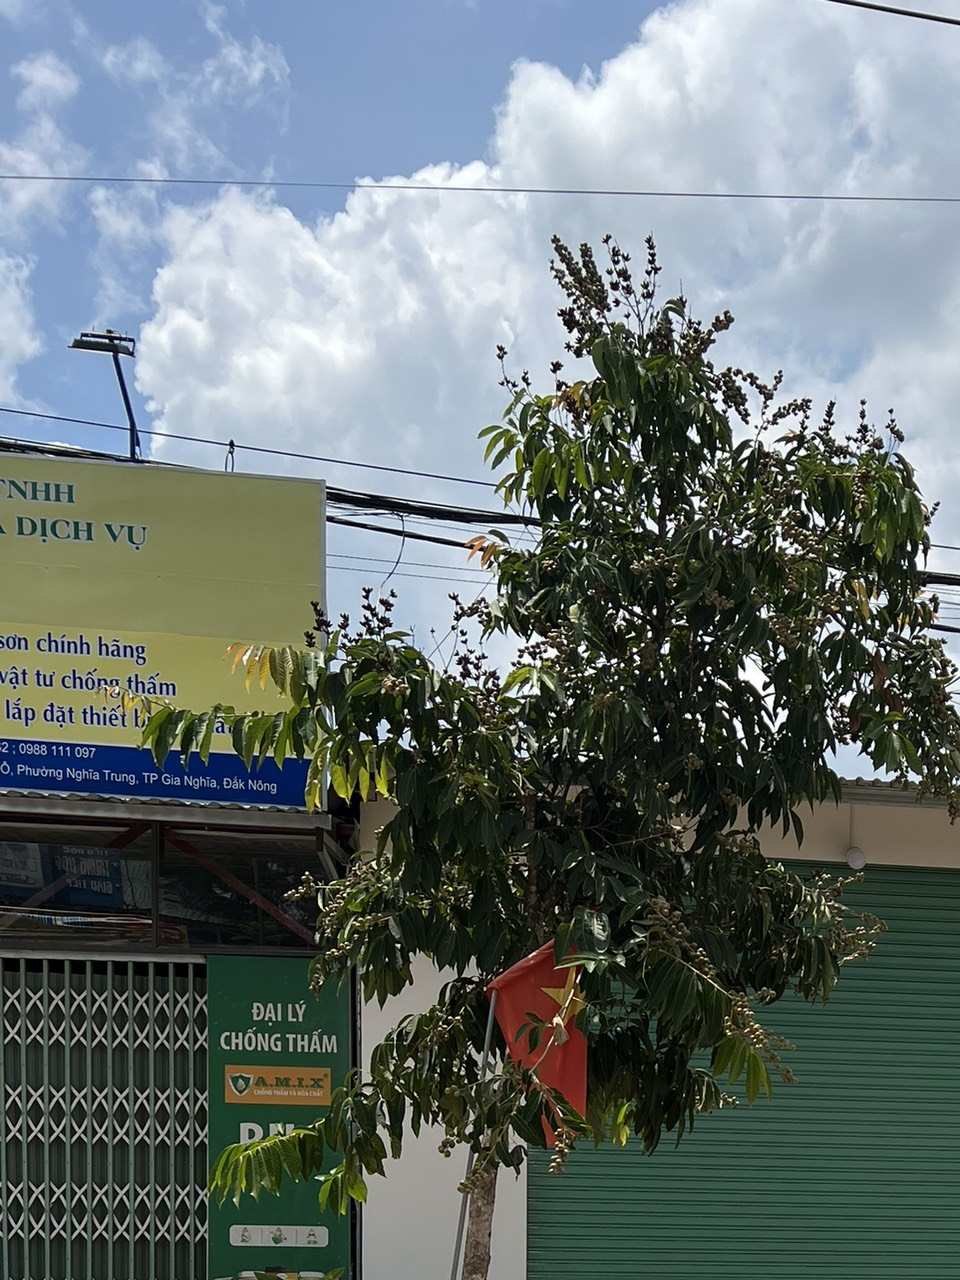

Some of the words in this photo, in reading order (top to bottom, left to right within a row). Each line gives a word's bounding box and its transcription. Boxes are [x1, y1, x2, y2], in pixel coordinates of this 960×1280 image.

[0, 479, 75, 504] NHH
[16, 516, 94, 543] DỊCH
[104, 523, 148, 551] VỤ
[36, 632, 91, 655] chính
[98, 636, 146, 666] hãng
[0, 666, 28, 690] vật
[35, 670, 55, 688] tư
[61, 668, 120, 698] chống
[126, 672, 177, 696] thấm
[5, 698, 36, 727] lắp
[43, 702, 75, 728] đặt
[82, 704, 127, 728] thiết
[19, 743, 47, 756] 0988
[51, 745, 71, 757] 111
[74, 746, 96, 758] 097
[17, 764, 63, 780] Phường
[66, 768, 100, 782] Nghĩa
[103, 770, 139, 786] Trung,
[142, 772, 158, 784] TP
[161, 774, 181, 786] Gia
[184, 775, 220, 790] Nghĩa,
[223, 775, 245, 790] Đắk
[248, 779, 277, 794] Nông
[251, 1002, 282, 1026] ĐẠI
[287, 1000, 307, 1022] LÝ
[220, 1027, 282, 1052] CHỐNG
[286, 1029, 338, 1053] THẤM
